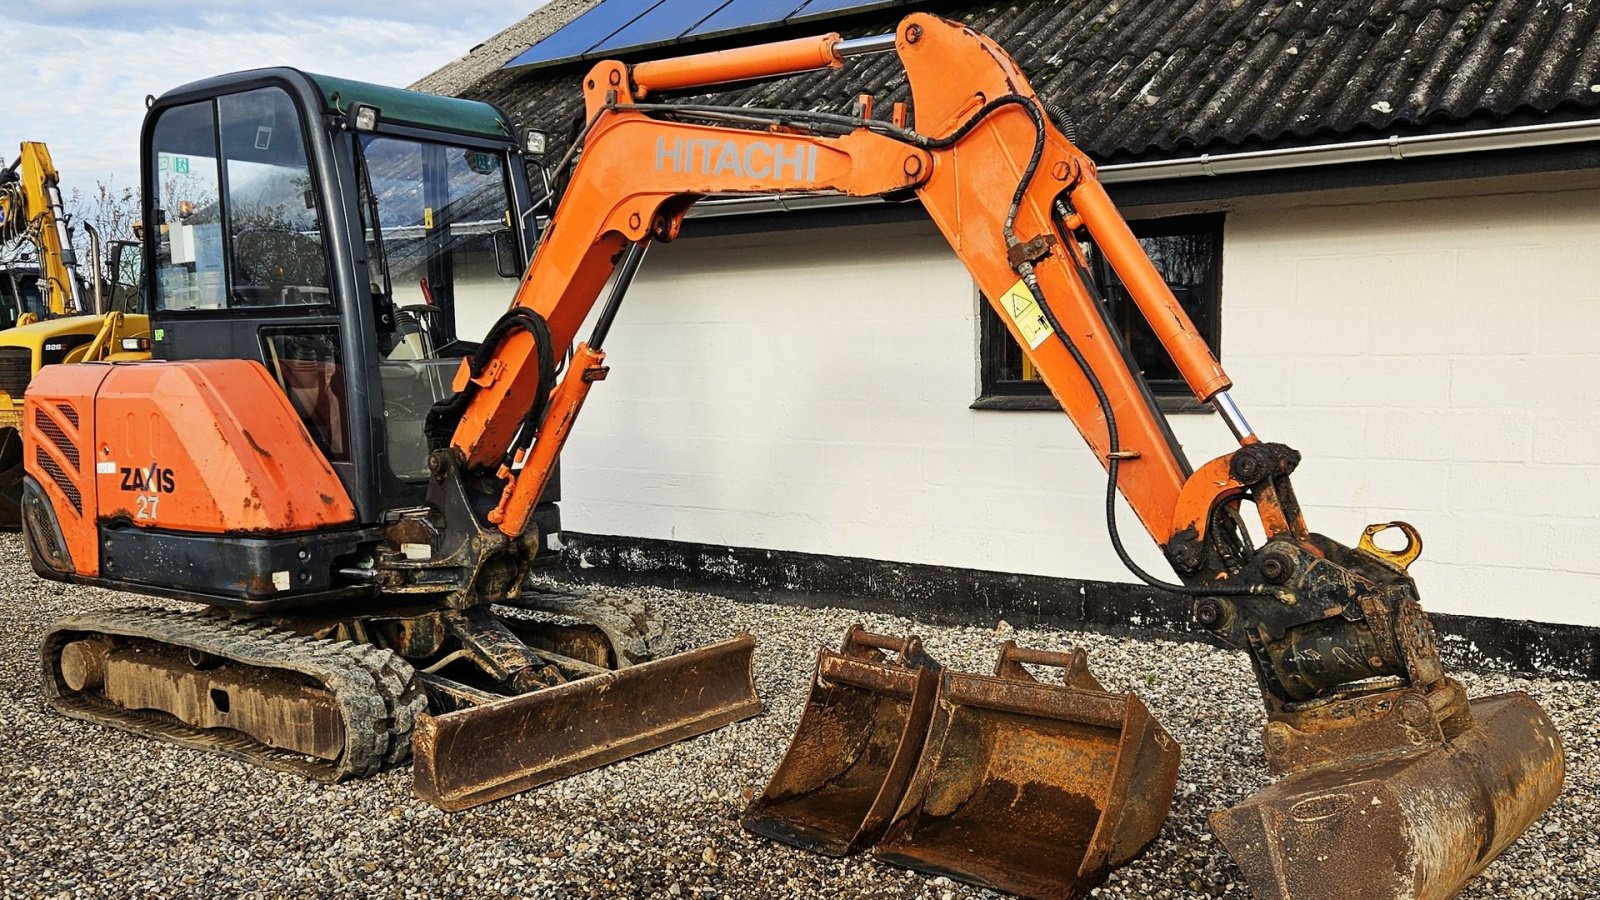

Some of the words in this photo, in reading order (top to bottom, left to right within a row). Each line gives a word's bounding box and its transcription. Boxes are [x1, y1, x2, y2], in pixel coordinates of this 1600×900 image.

[655, 135, 818, 183] HITACHI
[119, 462, 175, 494] ZAXIS
[135, 494, 160, 520] 27
